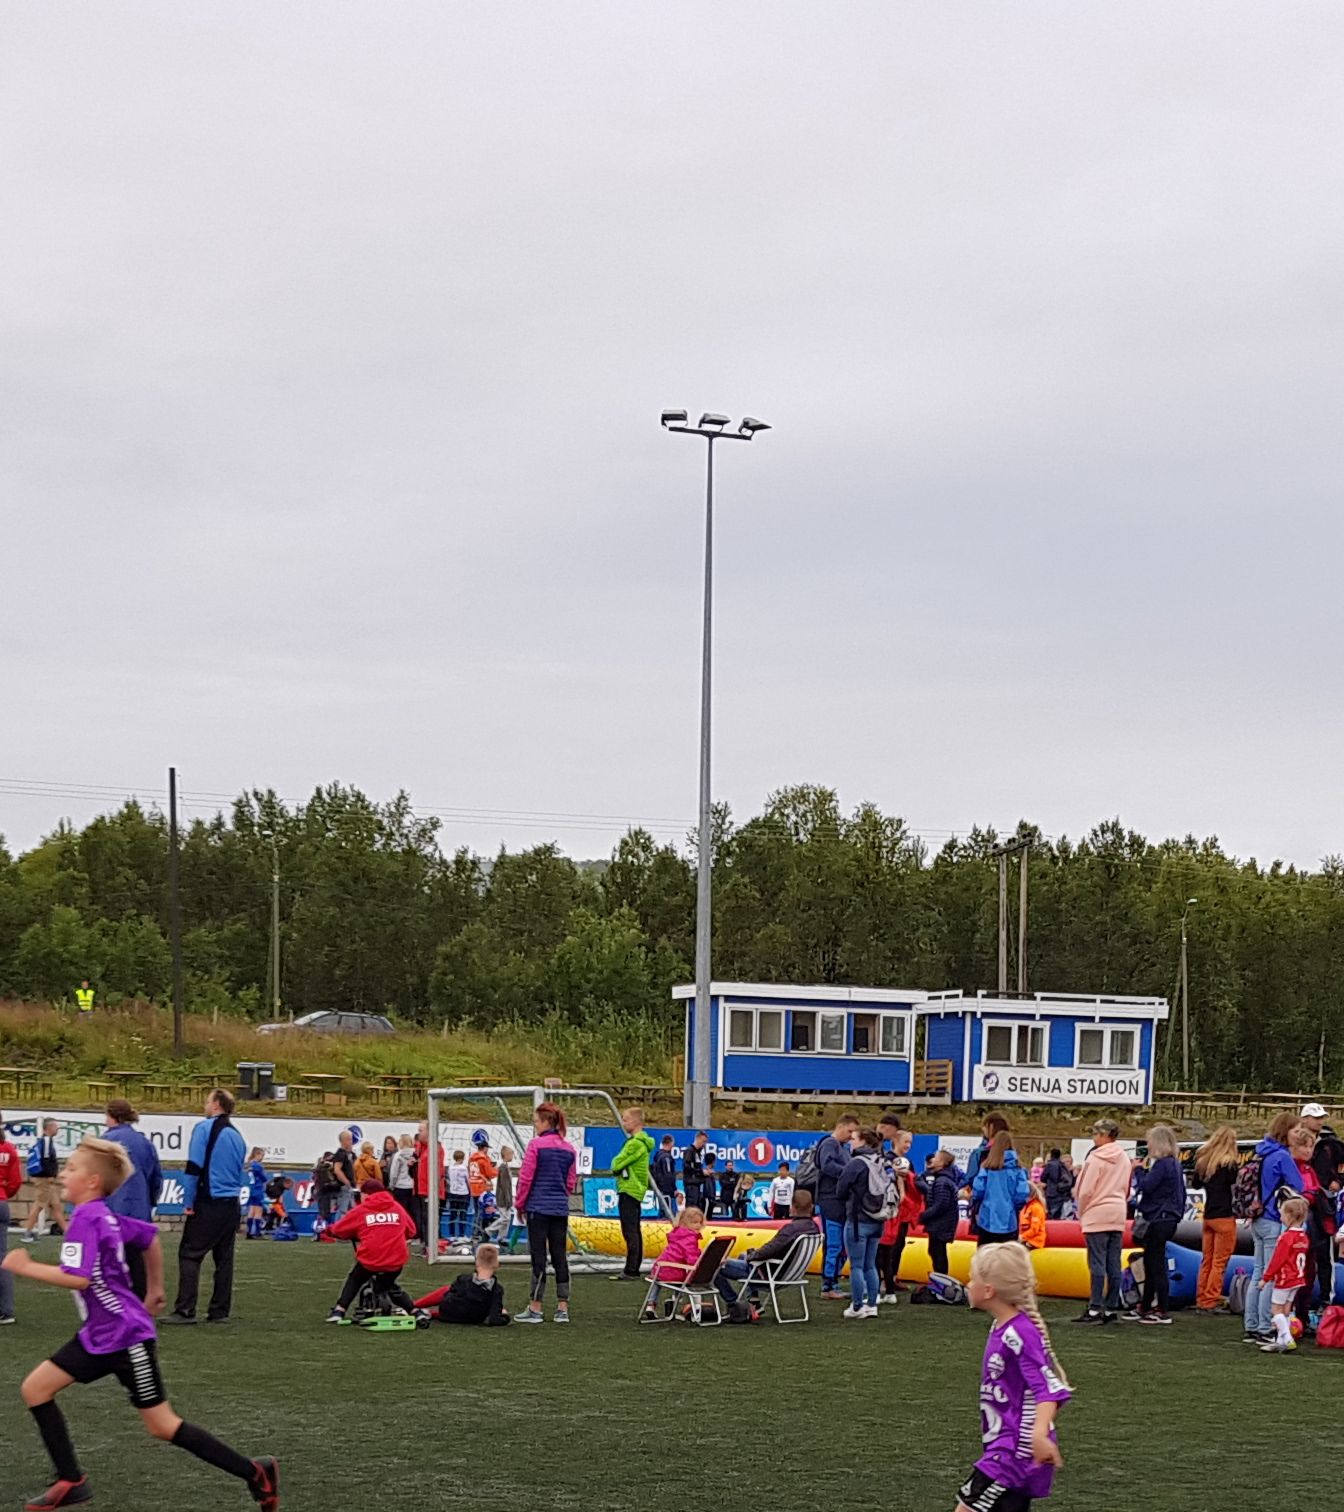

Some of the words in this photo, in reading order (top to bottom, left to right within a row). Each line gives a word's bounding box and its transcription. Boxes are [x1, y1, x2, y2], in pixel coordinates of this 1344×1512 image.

[1007, 1076, 1062, 1093] SENJA
[1067, 1079, 1139, 1095] STADION
[365, 1212, 400, 1225] BOIF
